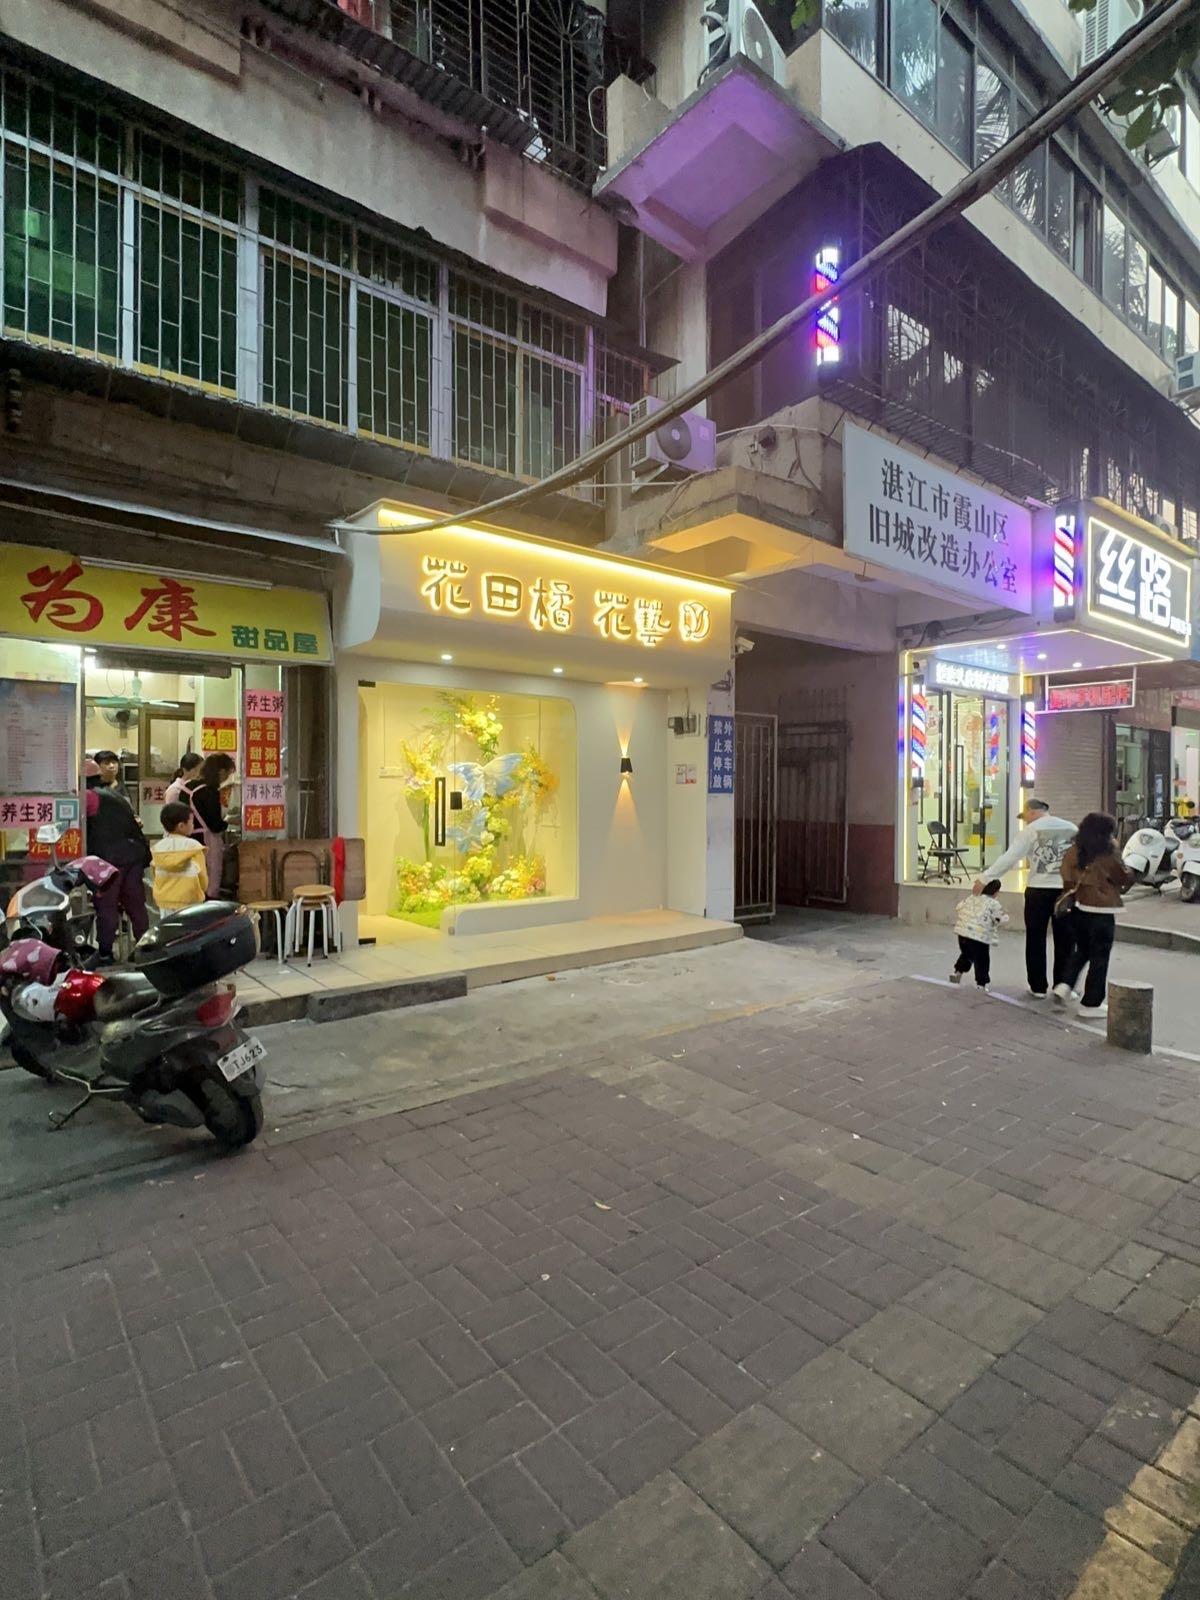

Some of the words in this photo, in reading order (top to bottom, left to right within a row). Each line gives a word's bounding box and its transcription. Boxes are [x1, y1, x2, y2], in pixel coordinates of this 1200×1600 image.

[881, 458, 1008, 546] 湛江市霞山区
[869, 503, 1018, 594] 旧城改造办公室
[1099, 529, 1172, 628] 丝路
[20, 563, 216, 642] 为康
[421, 556, 574, 631] 花田橘
[231, 625, 319, 655] 甜品屋
[247, 694, 284, 713] 养生粥
[713, 720, 723, 789] 禁止停放
[723, 721, 733, 789] 外来车辆
[1, 802, 53, 823] 养生粥
[143, 786, 168, 801] 养生
[246, 784, 284, 800] 清补凉
